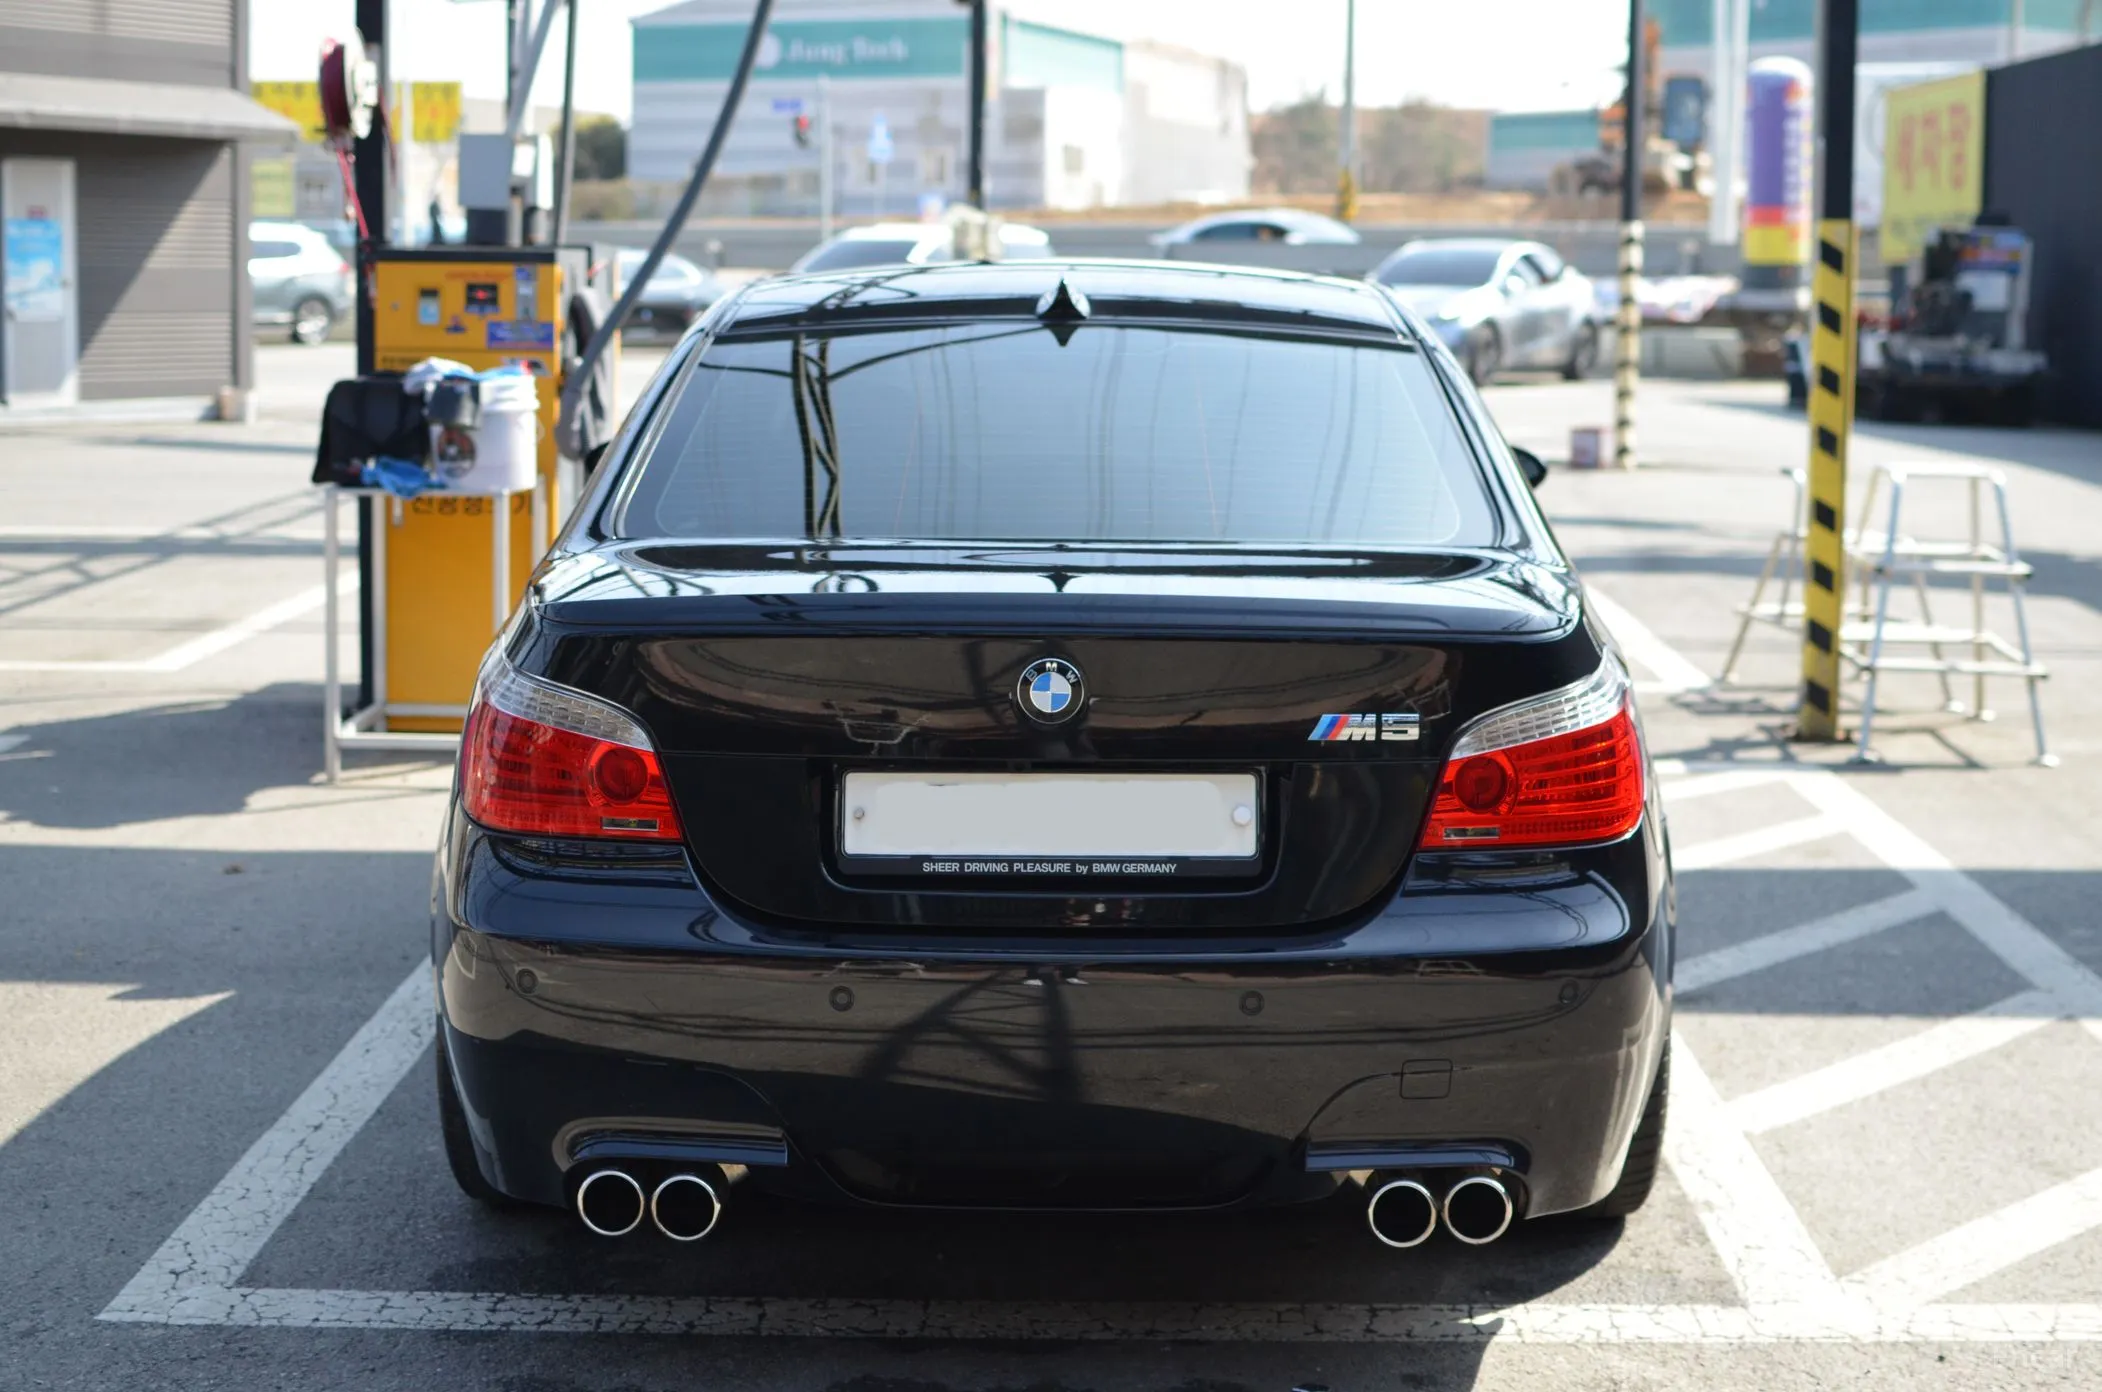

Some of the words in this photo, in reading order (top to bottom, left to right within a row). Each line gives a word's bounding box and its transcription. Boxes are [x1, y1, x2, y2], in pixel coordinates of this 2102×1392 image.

[1025, 661, 1078, 684] BMW
[1318, 713, 1420, 741] M5
[922, 862, 960, 873] SHEER
[964, 862, 1009, 873] DRIVING
[1013, 862, 1071, 873] PLEASURE
[1075, 863, 1088, 875] by
[1092, 863, 1120, 873] BMW
[1122, 863, 1177, 874] GERMANY
